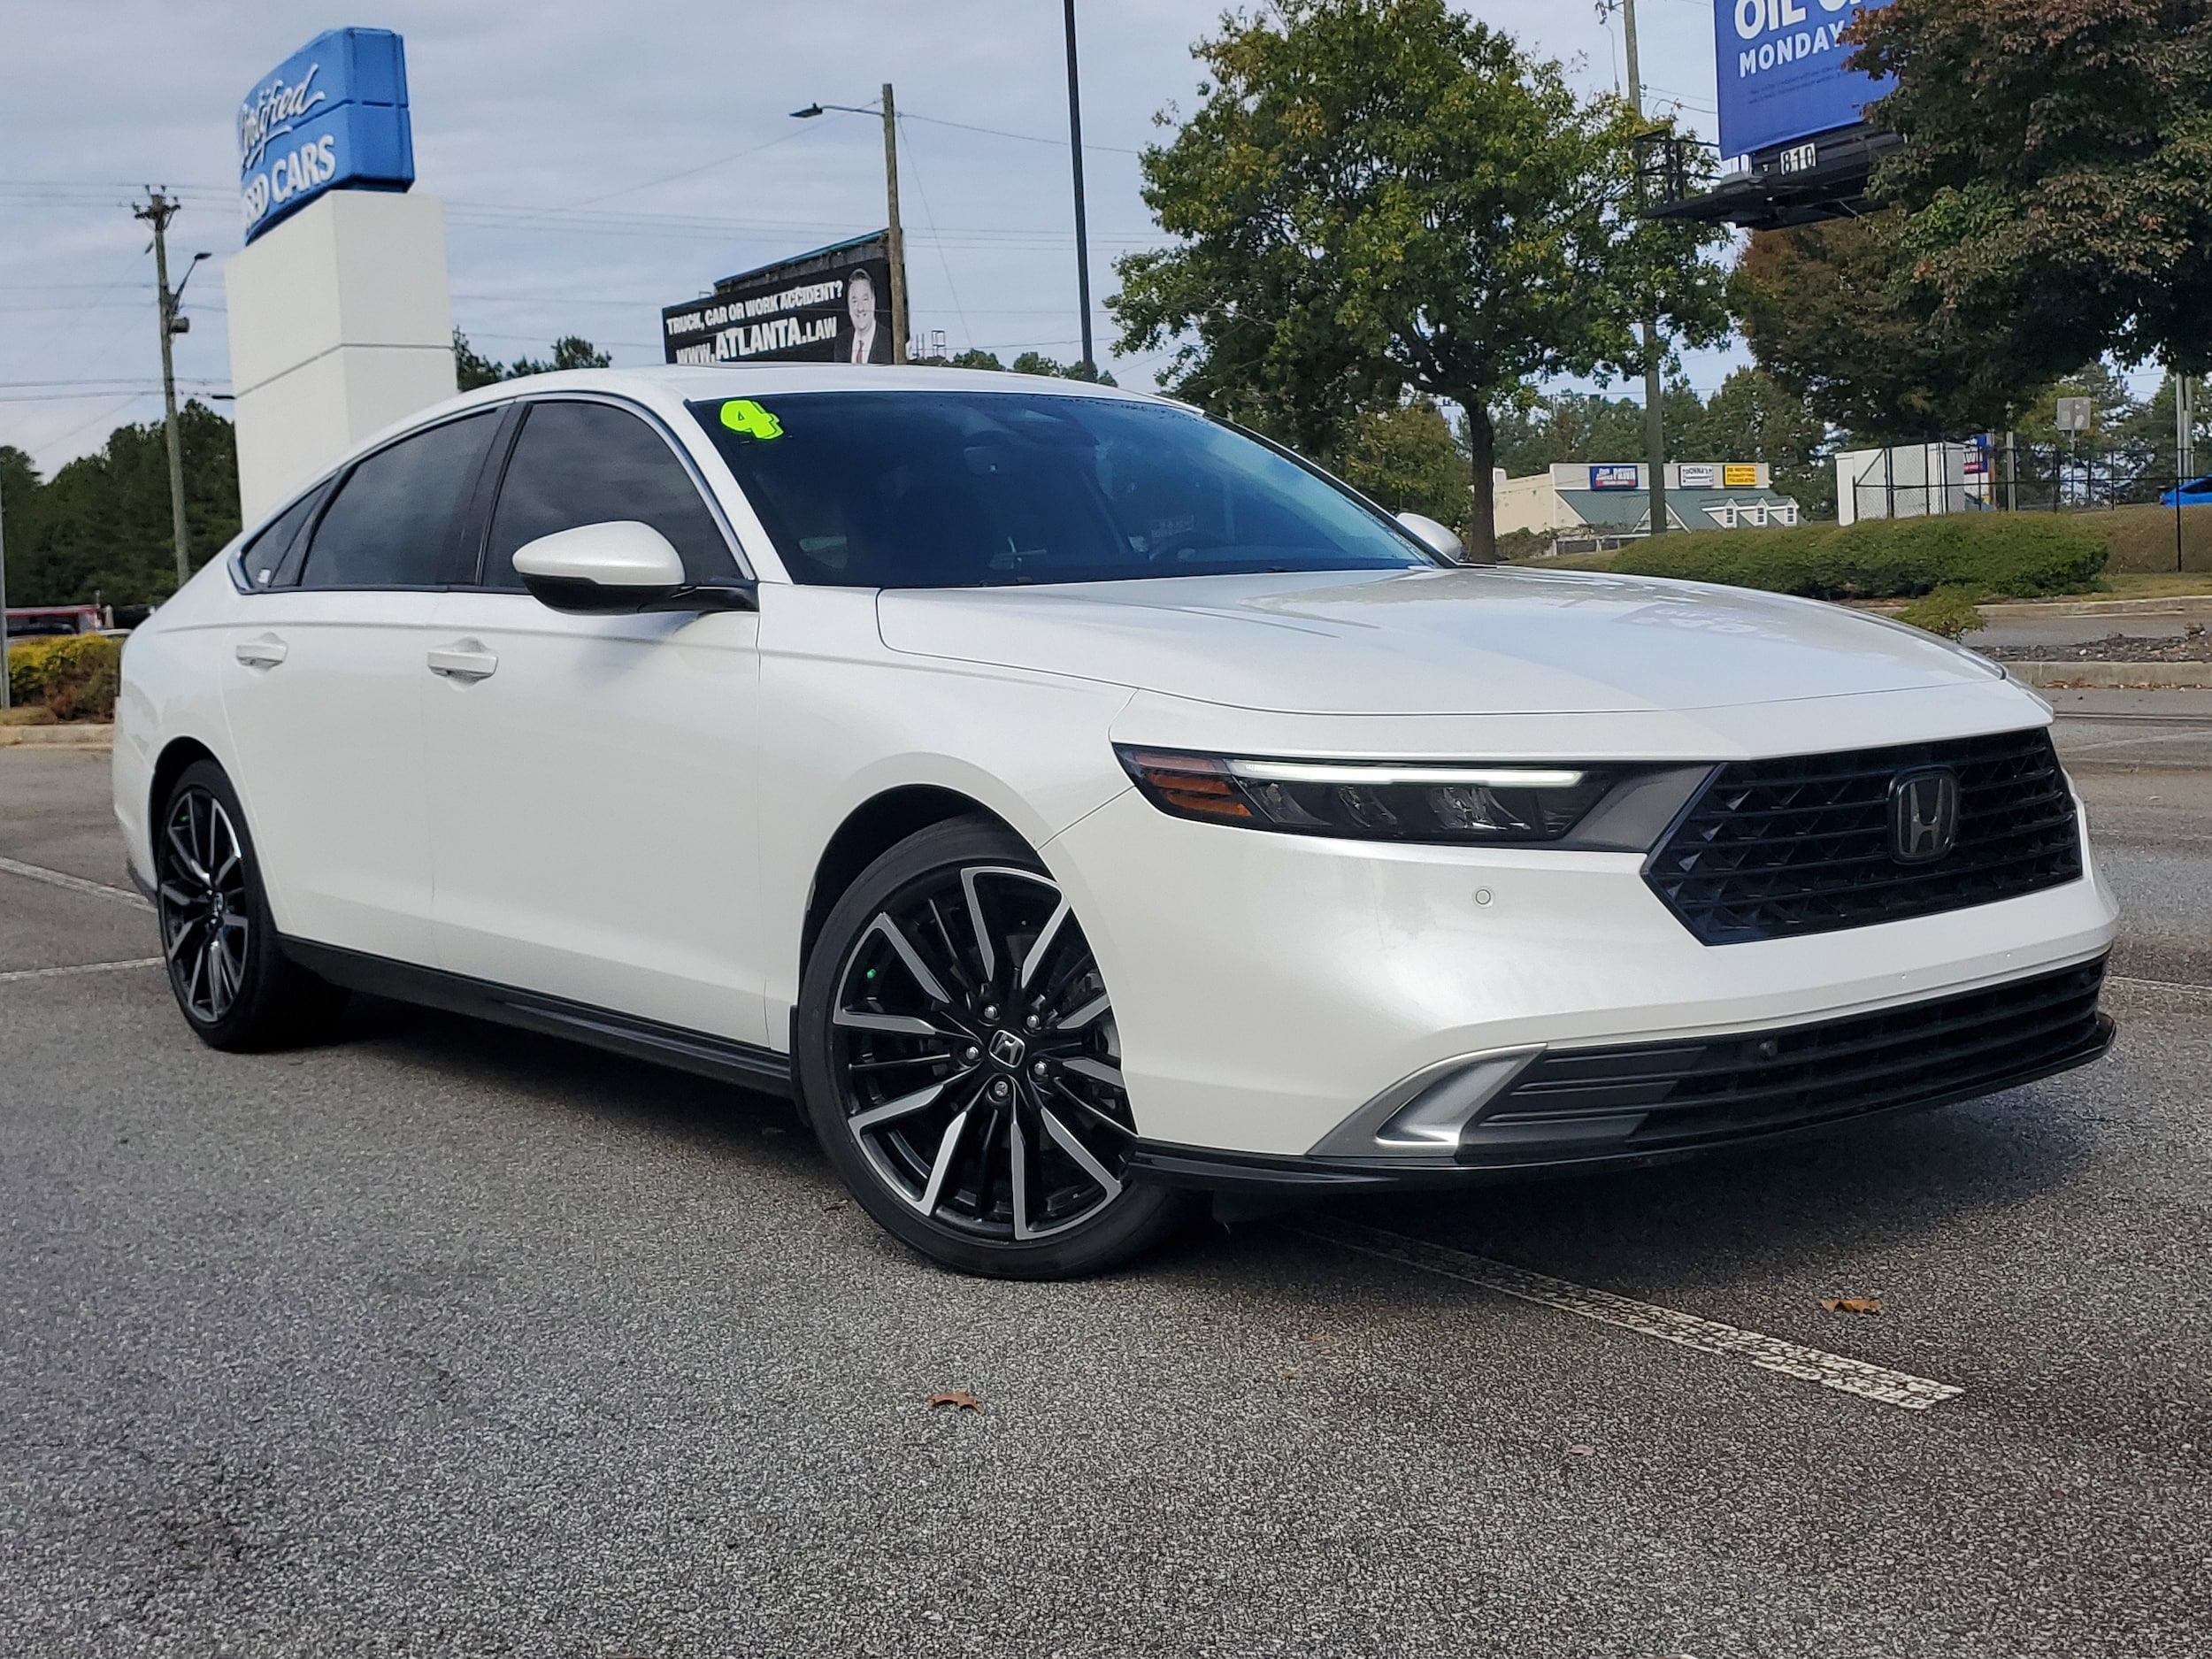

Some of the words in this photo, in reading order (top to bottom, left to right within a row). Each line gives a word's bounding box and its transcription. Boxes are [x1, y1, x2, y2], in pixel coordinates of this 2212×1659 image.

[1740, 20, 1845, 78] MONDAY
[271, 134, 335, 204] CARS
[1782, 147, 1814, 173] 810
[666, 311, 705, 335] TRUCK,
[704, 306, 728, 326] CAR
[728, 302, 745, 321] OR
[744, 299, 780, 317] WORK
[780, 280, 843, 309] ACCIDENT?
[720, 400, 784, 440] 4
